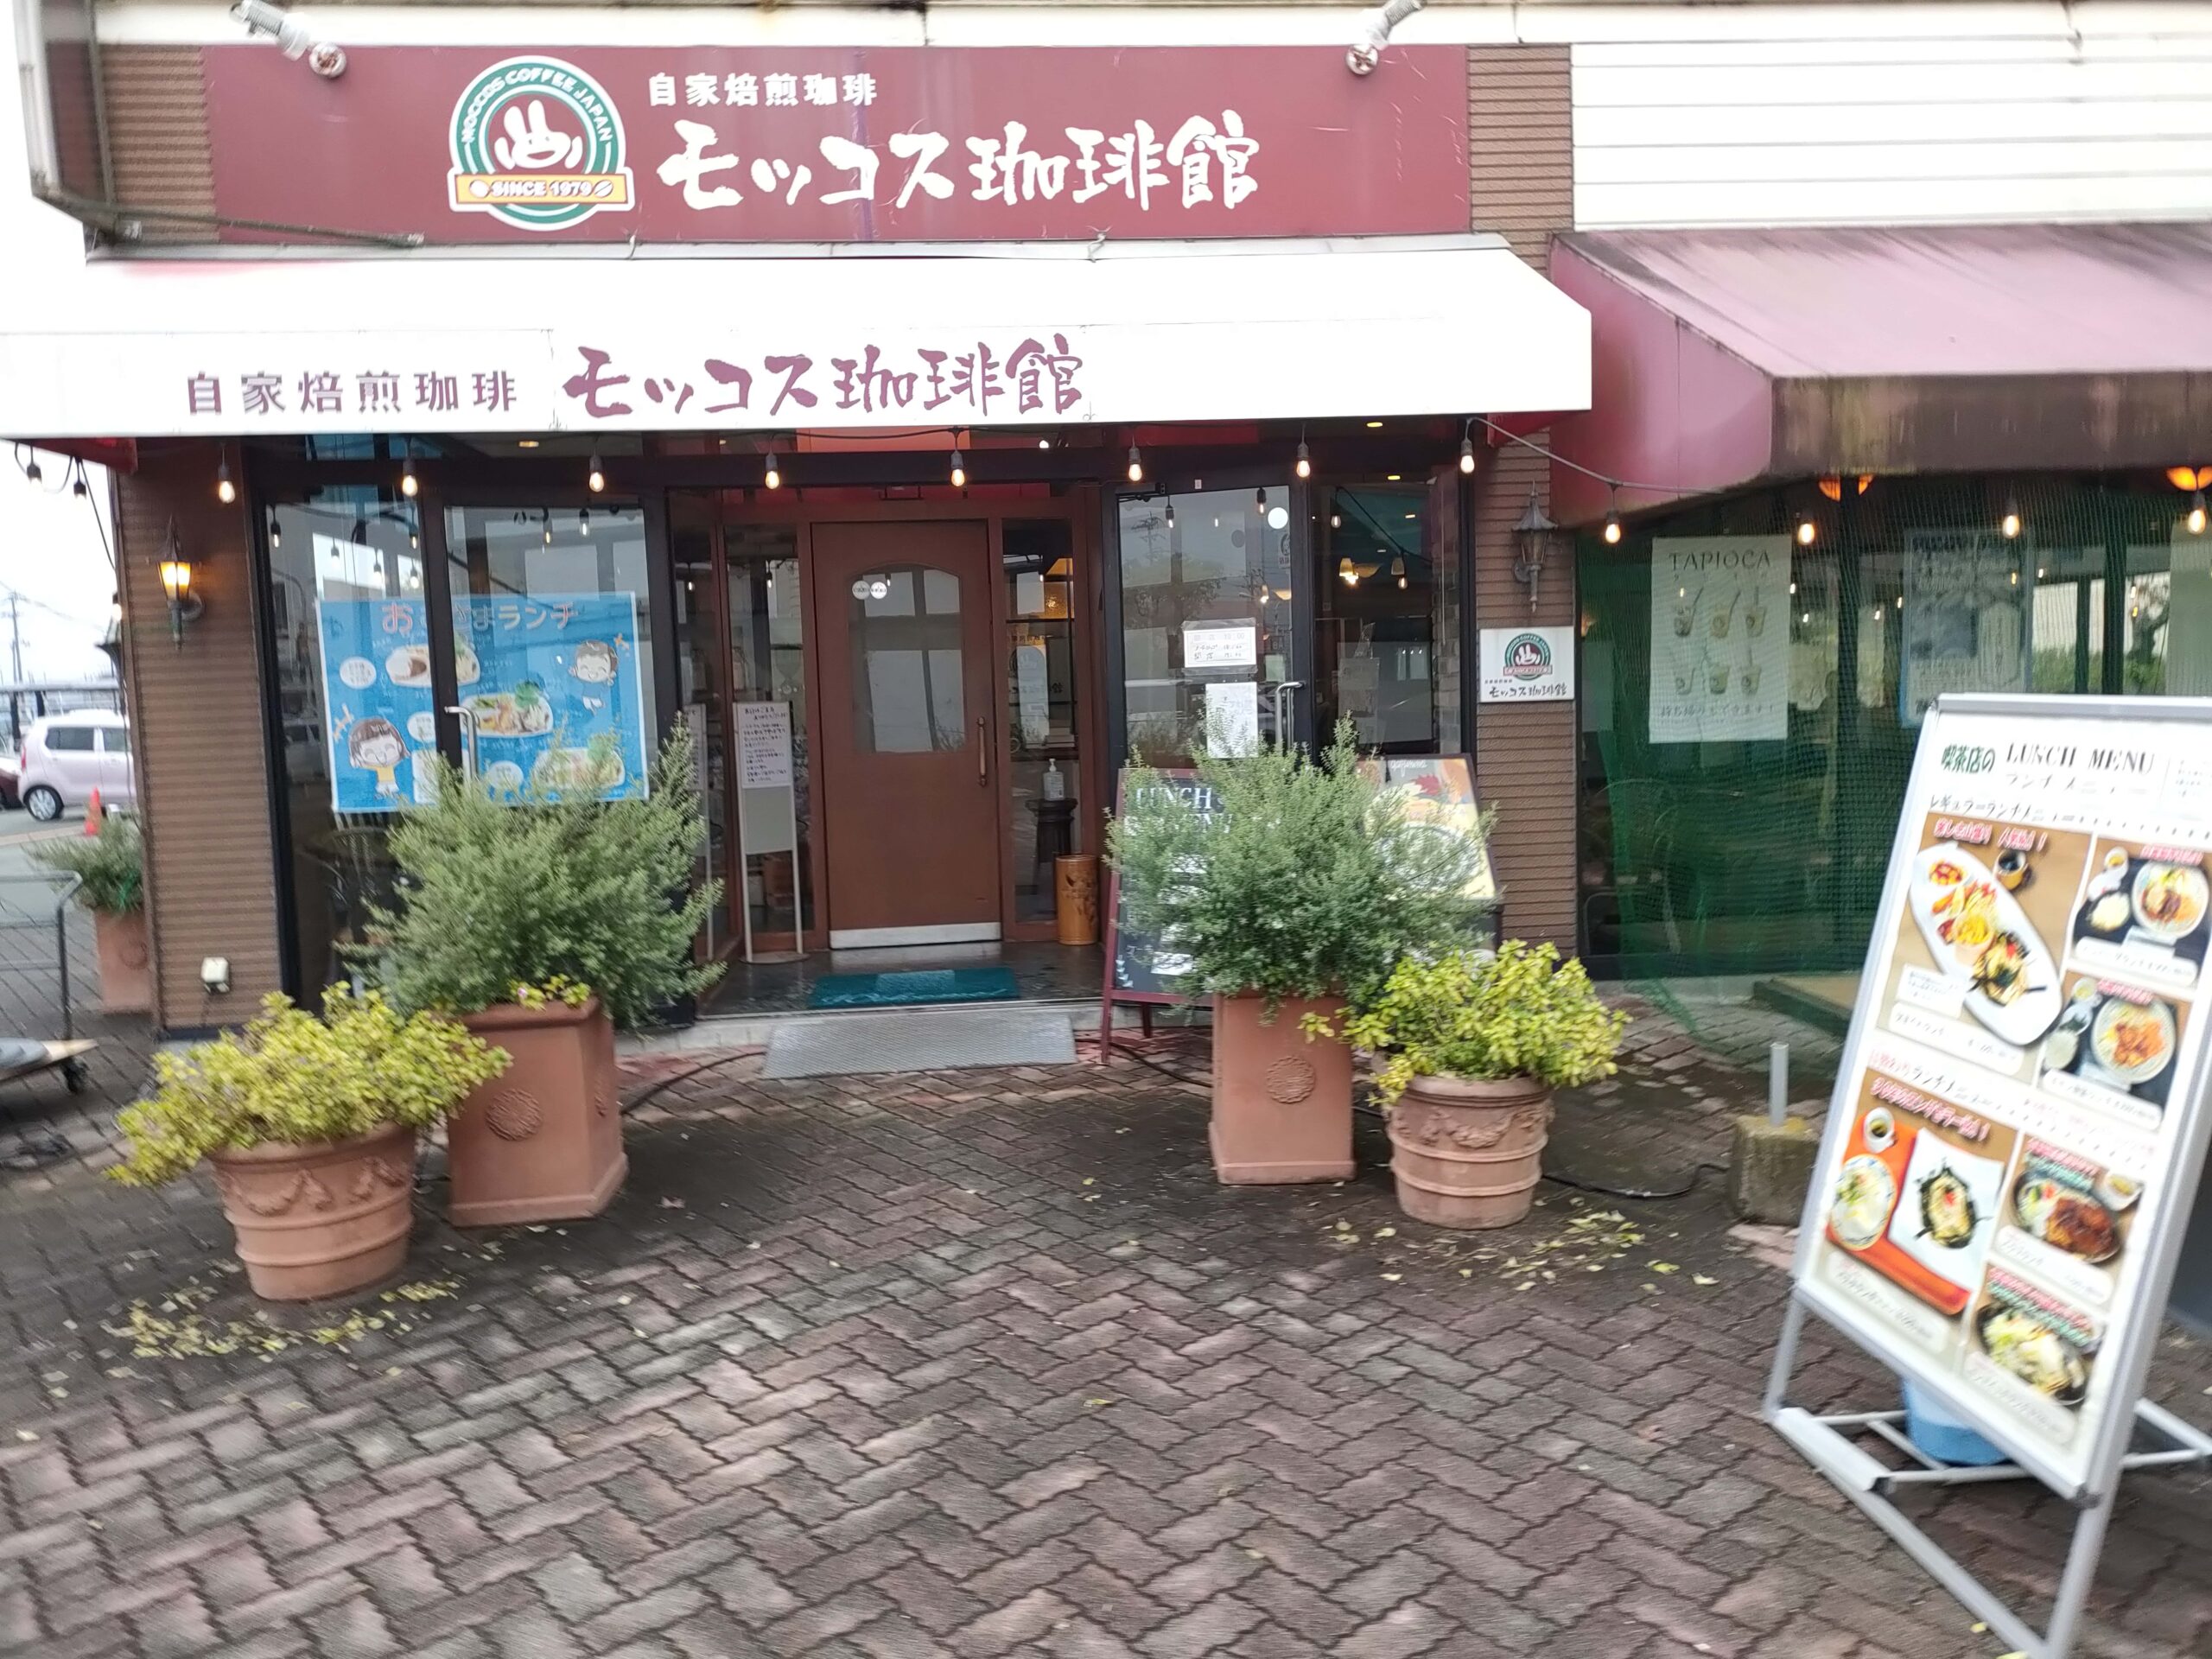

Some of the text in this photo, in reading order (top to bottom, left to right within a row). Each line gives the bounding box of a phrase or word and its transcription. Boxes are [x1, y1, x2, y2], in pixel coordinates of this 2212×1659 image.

[505, 67, 577, 93] COFFEE
[573, 87, 613, 143] JAPAN
[648, 72, 878, 107] 自家焙煎珈琲
[656, 109, 1261, 211] モッコス珈琲館
[490, 180, 593, 198] SINCE 1979
[187, 370, 518, 415] 自家焙煎珈琲
[562, 333, 1084, 419] モッコス珈琲館
[1668, 549, 1771, 572] TAPIOCA
[1941, 741, 2156, 775] 喫茶店の LUNCH MENU
